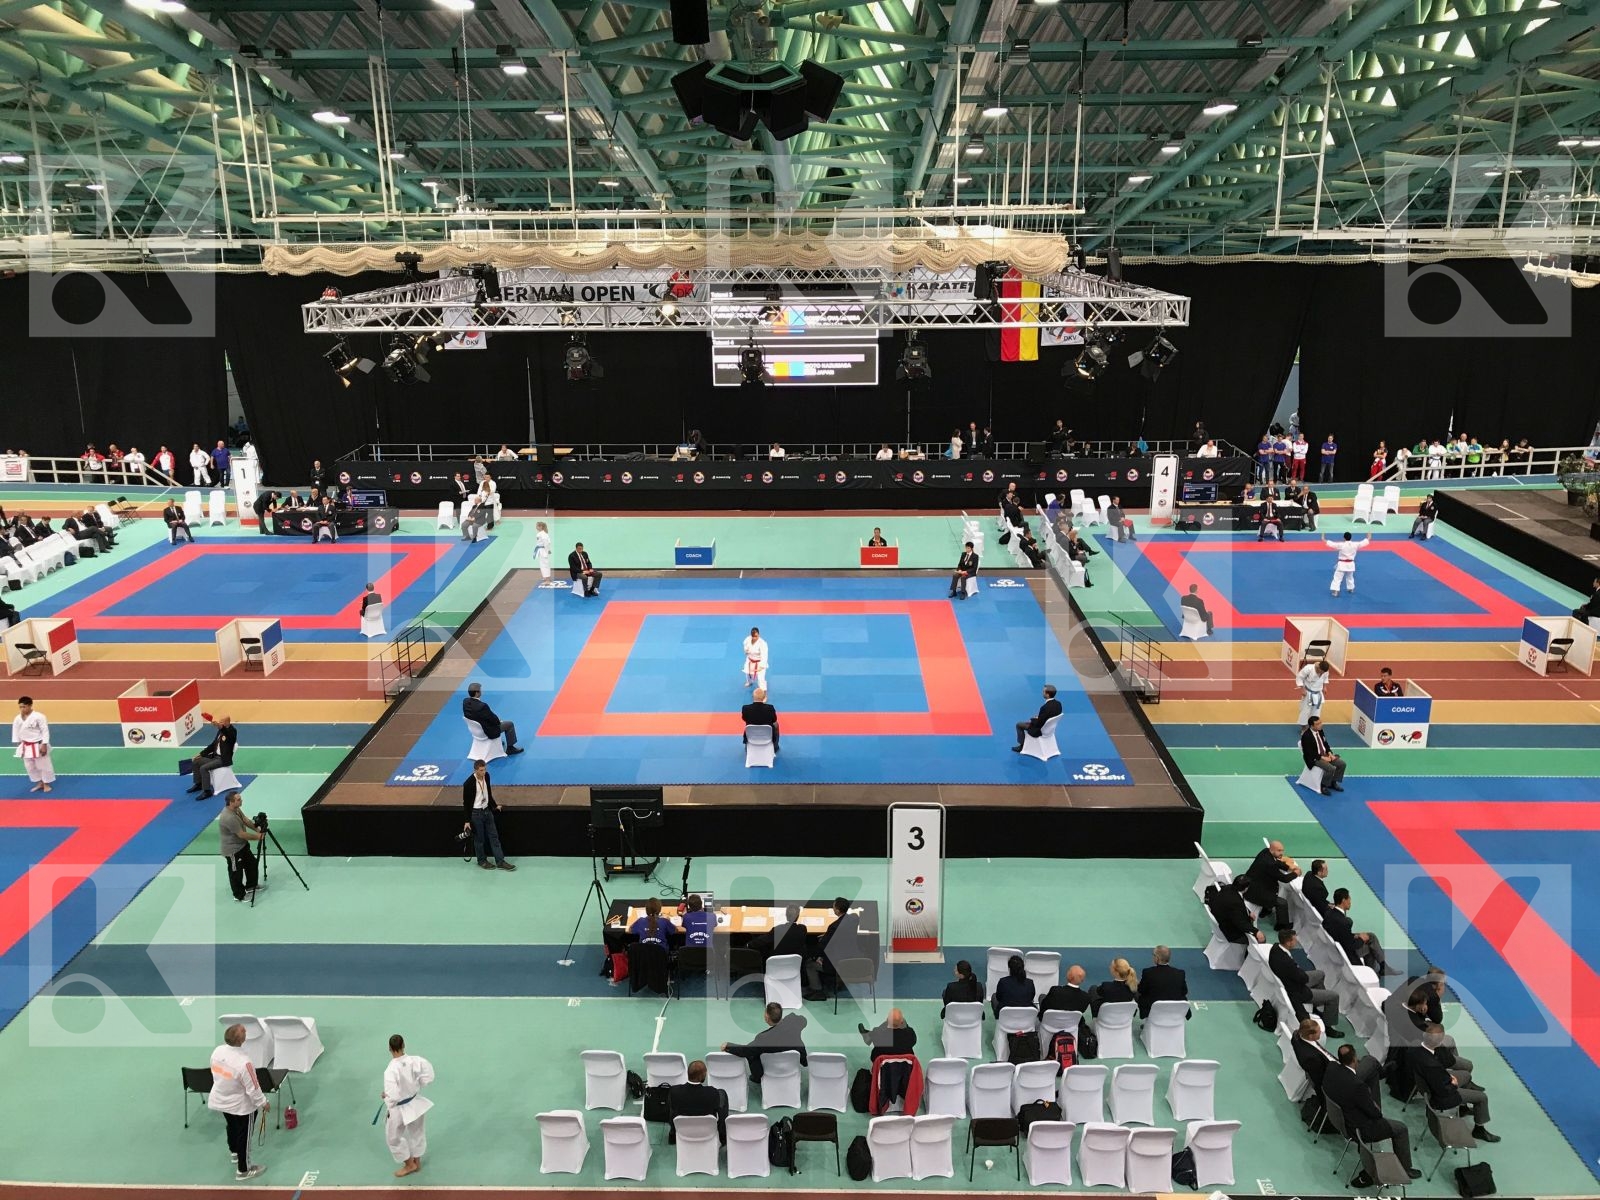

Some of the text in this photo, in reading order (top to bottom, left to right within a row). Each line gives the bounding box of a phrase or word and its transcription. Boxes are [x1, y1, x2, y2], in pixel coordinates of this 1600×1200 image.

[580, 285, 635, 302] OPEN
[240, 468, 247, 480] 1
[1160, 465, 1170, 478] 4
[393, 774, 448, 782] Hayashi
[907, 826, 925, 851] 3
[689, 931, 711, 939] CREW
